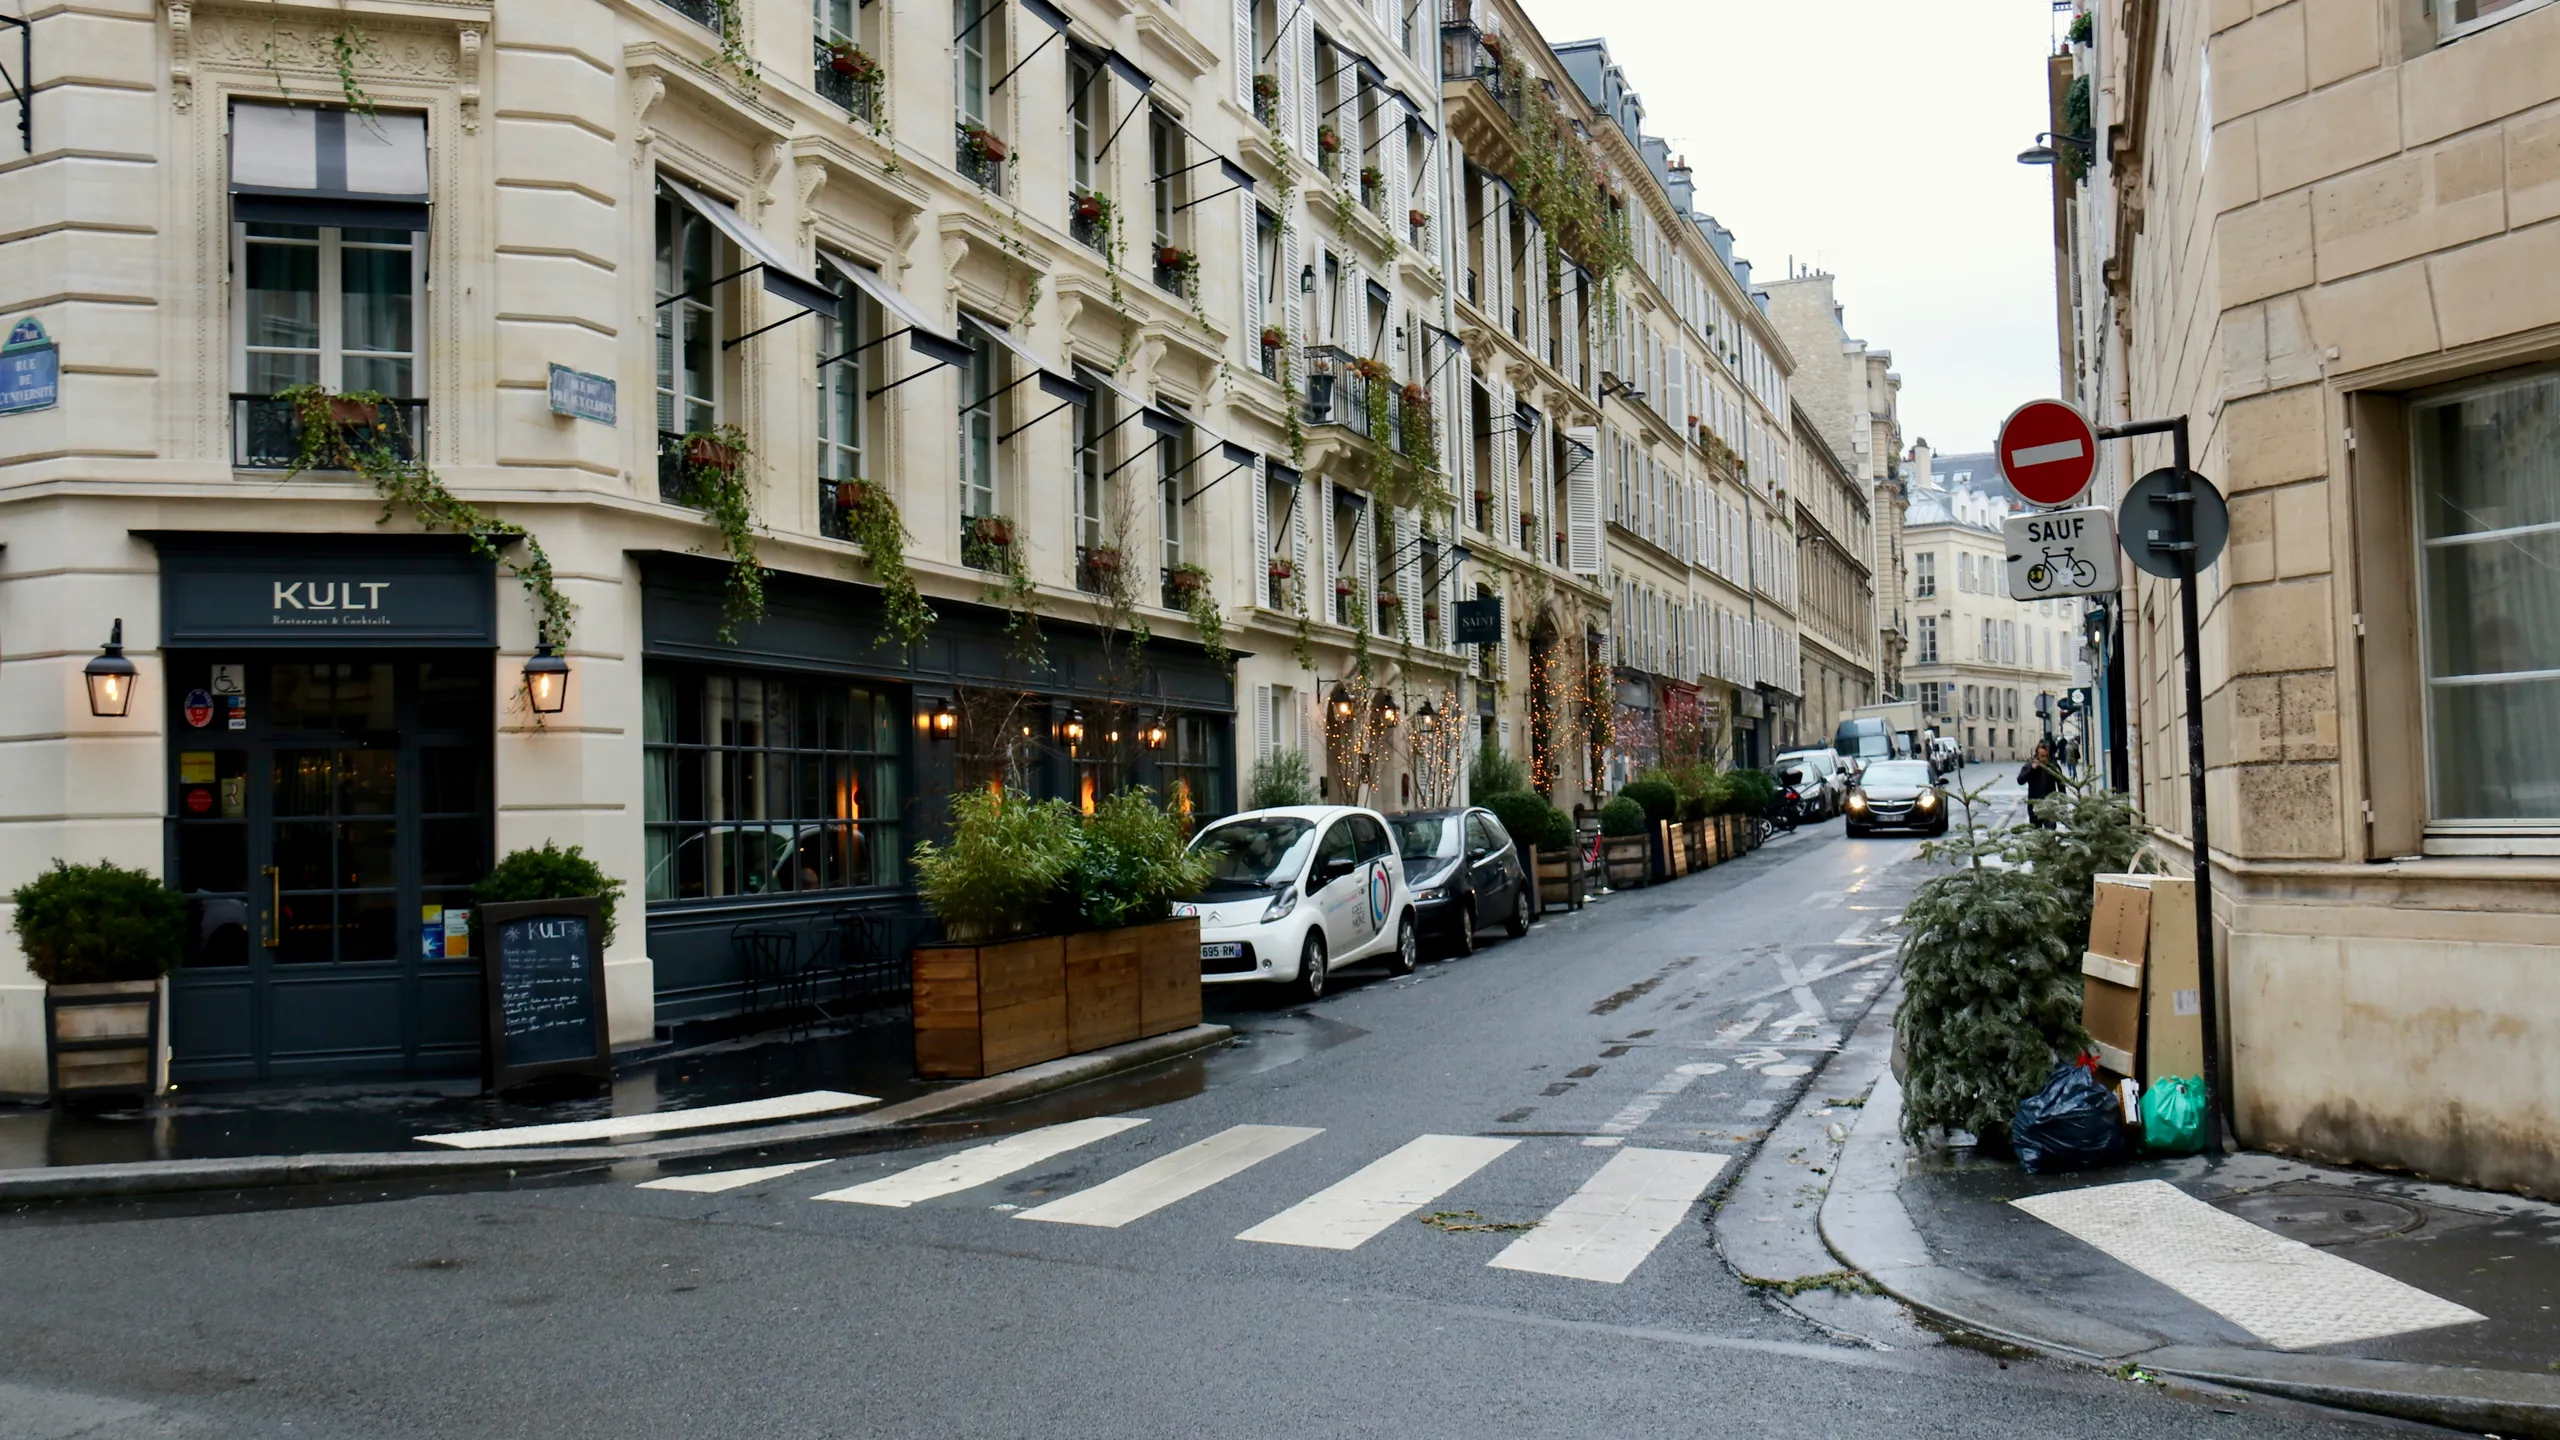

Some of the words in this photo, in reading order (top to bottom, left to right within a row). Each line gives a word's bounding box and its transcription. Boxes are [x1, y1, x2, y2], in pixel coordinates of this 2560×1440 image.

[15, 358, 36, 372] RUE
[18, 374, 33, 386] DE
[2028, 517, 2084, 543] SAUF
[273, 581, 391, 610] KULT
[272, 614, 328, 625] Restaurant
[342, 615, 392, 625] Cocktails
[1462, 616, 1495, 627] SAINT
[527, 920, 575, 941] KULT
